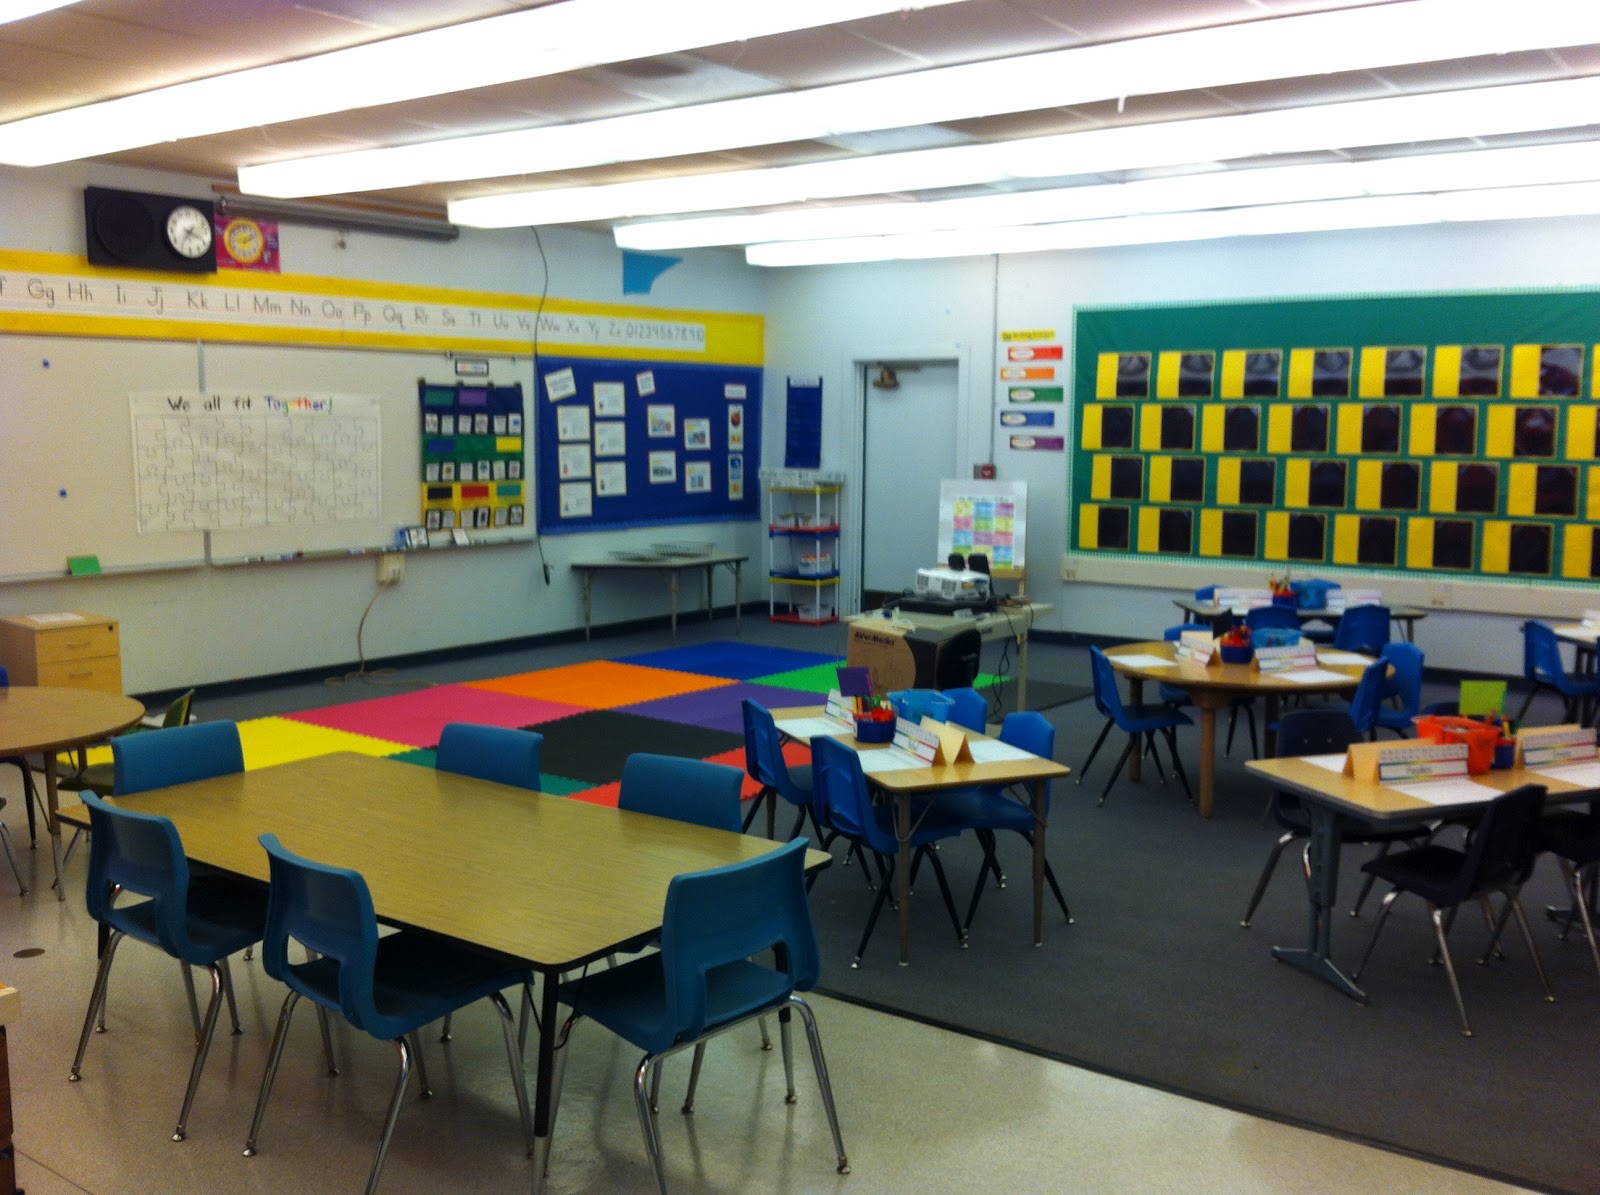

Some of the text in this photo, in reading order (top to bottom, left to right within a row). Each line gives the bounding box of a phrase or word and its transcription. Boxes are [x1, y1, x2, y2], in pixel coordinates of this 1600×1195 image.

[27, 277, 55, 308] Gg
[67, 282, 93, 303] Hh
[116, 283, 127, 304] Ii
[147, 286, 164, 315] Jj
[187, 289, 209, 310] Kk
[225, 293, 240, 313] Ll
[254, 294, 281, 314] Mm
[291, 297, 311, 317] Nn
[321, 300, 343, 319] Oo
[353, 301, 372, 326] Pp
[383, 304, 405, 330] Qq
[167, 395, 190, 412] We
[204, 394, 221, 412] all
